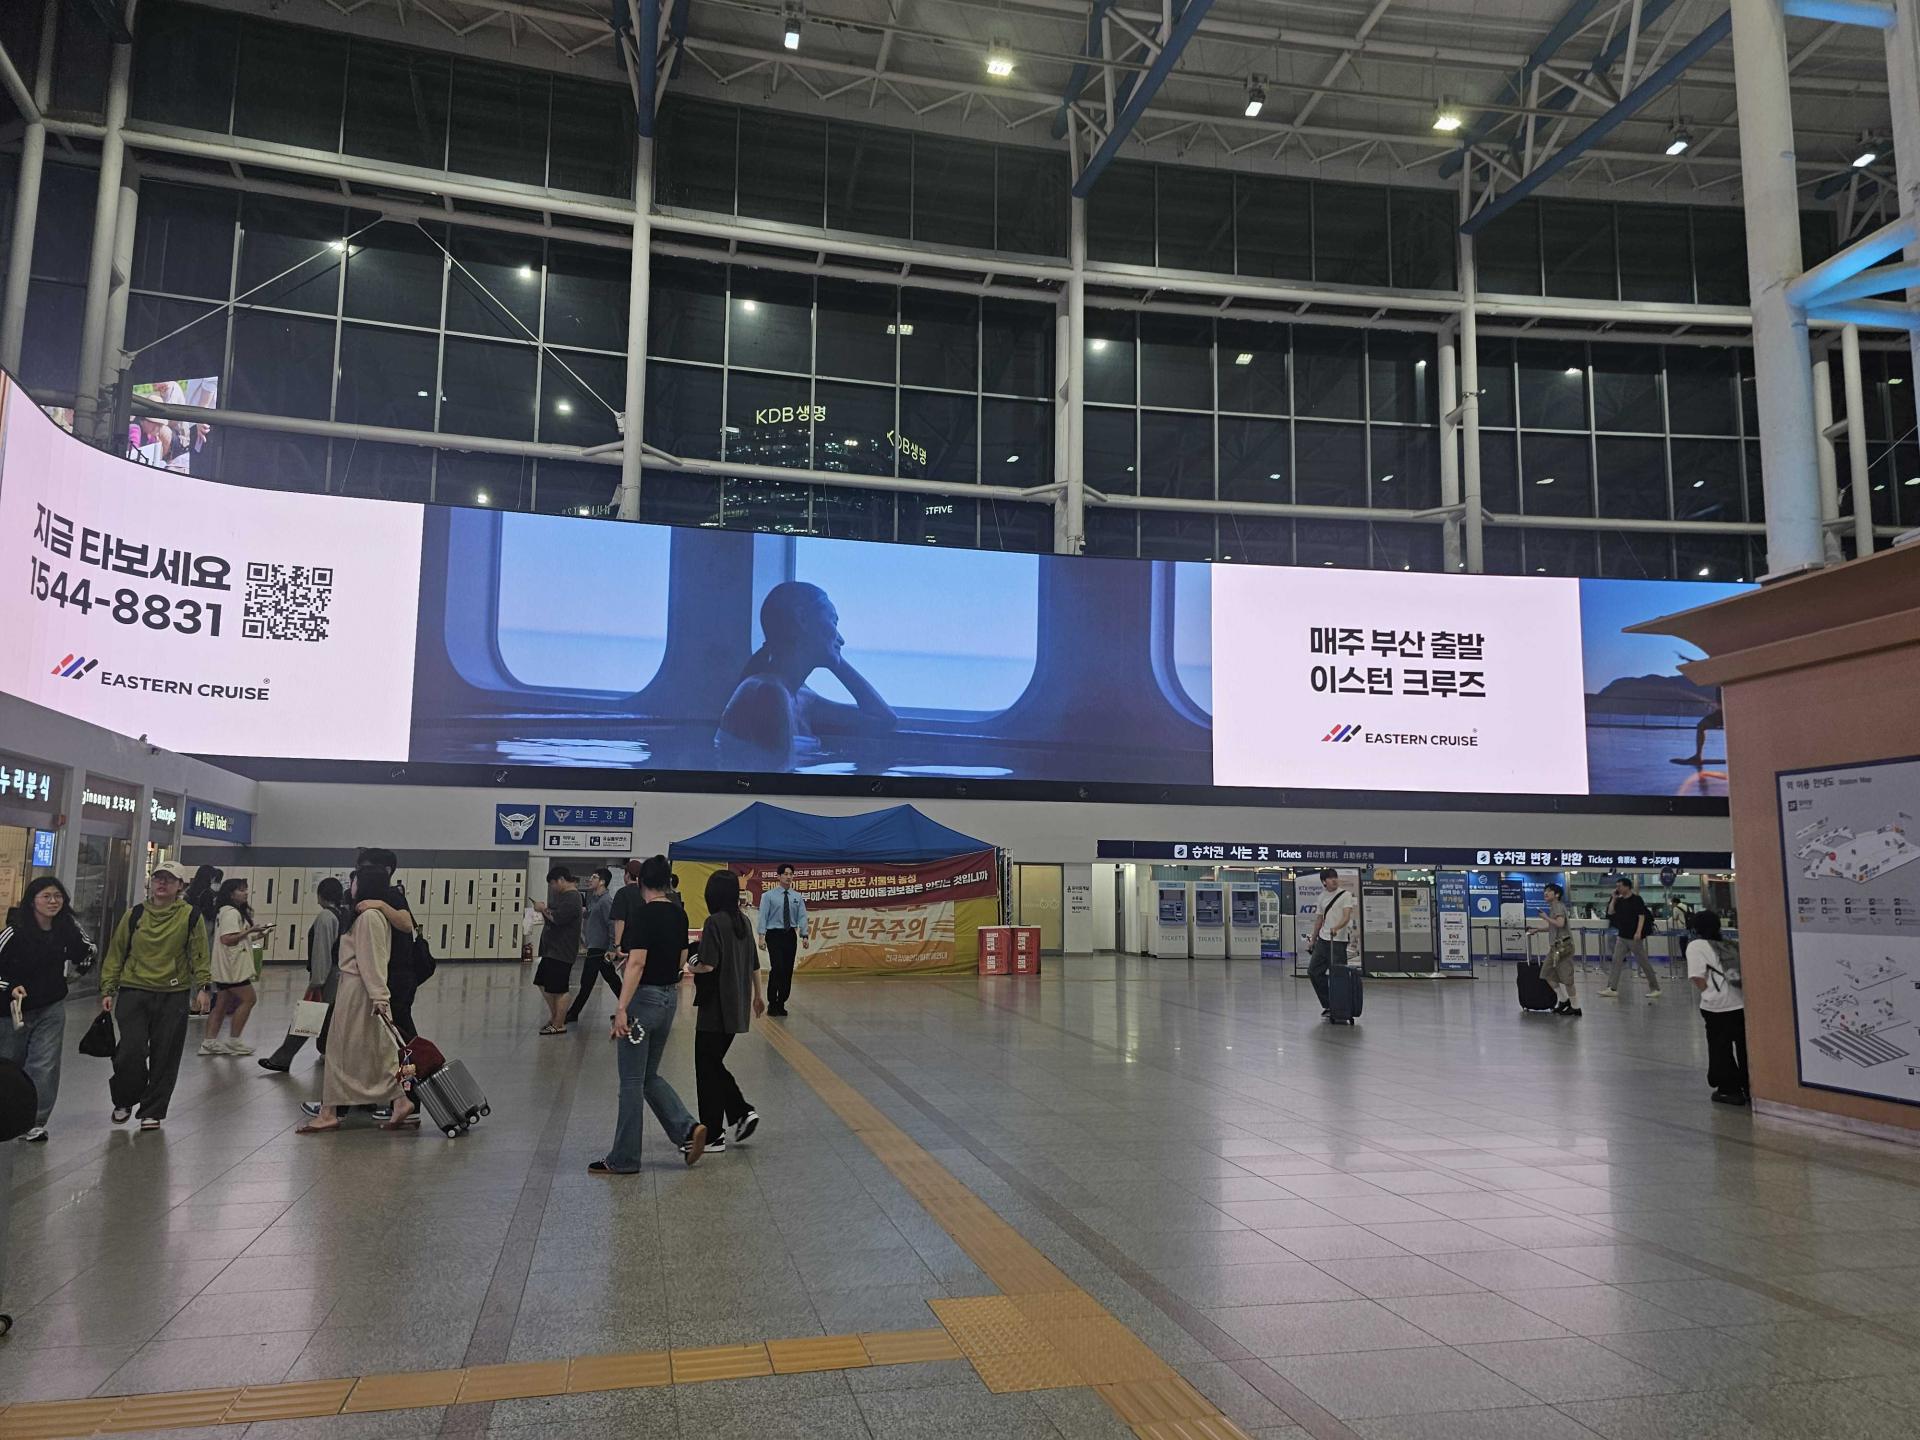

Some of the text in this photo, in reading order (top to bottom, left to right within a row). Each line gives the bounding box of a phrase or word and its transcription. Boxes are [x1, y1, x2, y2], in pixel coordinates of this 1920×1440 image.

[756, 405, 826, 425] KDB생명
[34, 502, 231, 591] 지금 타보세요
[30, 555, 222, 637] 1544-8831
[1310, 627, 1485, 660] 매주 부산 출발
[101, 671, 270, 701] EASTERN CRUISE
[1310, 665, 1486, 698] 이스턴 크루즈
[1365, 733, 1478, 746] EASTERN CRUISE
[0, 766, 50, 802] 누리분식
[1192, 845, 1224, 859] 승차권
[1230, 846, 1253, 860] 사는
[1257, 846, 1269, 860] 곳
[1275, 849, 1301, 859] Tickets
[1493, 851, 1526, 865] 승차권
[1530, 852, 1552, 866] 변경
[1561, 852, 1583, 866] 반환
[1588, 855, 1614, 864] Tickets
[762, 874, 917, 891] 장애이동권대투쟁 선포 서울역 농성
[841, 884, 923, 899] 장애인이동권보장은
[953, 870, 988, 885] 것입니까
[847, 915, 928, 941] 민주주의
